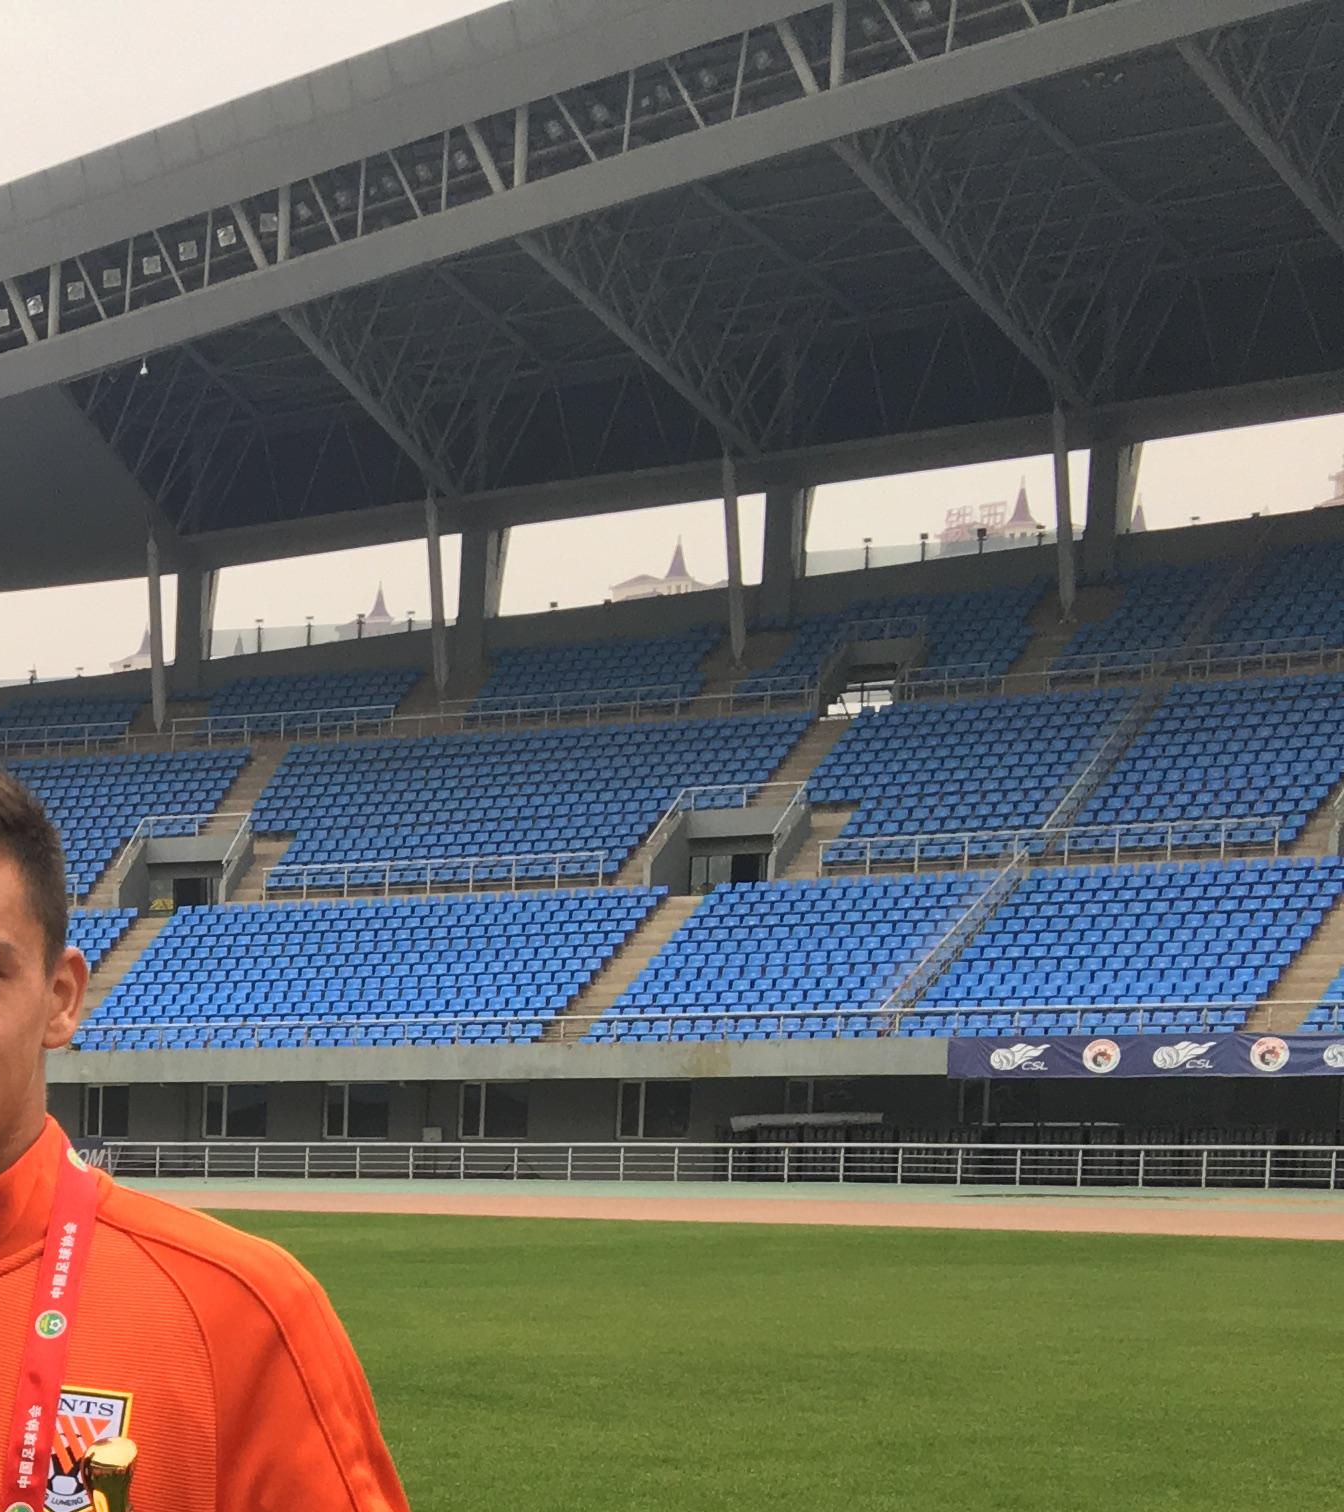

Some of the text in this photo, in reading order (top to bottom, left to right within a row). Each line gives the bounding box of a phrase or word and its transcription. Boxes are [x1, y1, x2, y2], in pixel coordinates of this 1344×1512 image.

[1021, 1061, 1049, 1071] CSL
[1186, 1059, 1214, 1069] CSL
[50, 1222, 77, 1299] 中国足球协会
[59, 1398, 115, 1417] NTS
[16, 1404, 44, 1489] 中国足球协会
